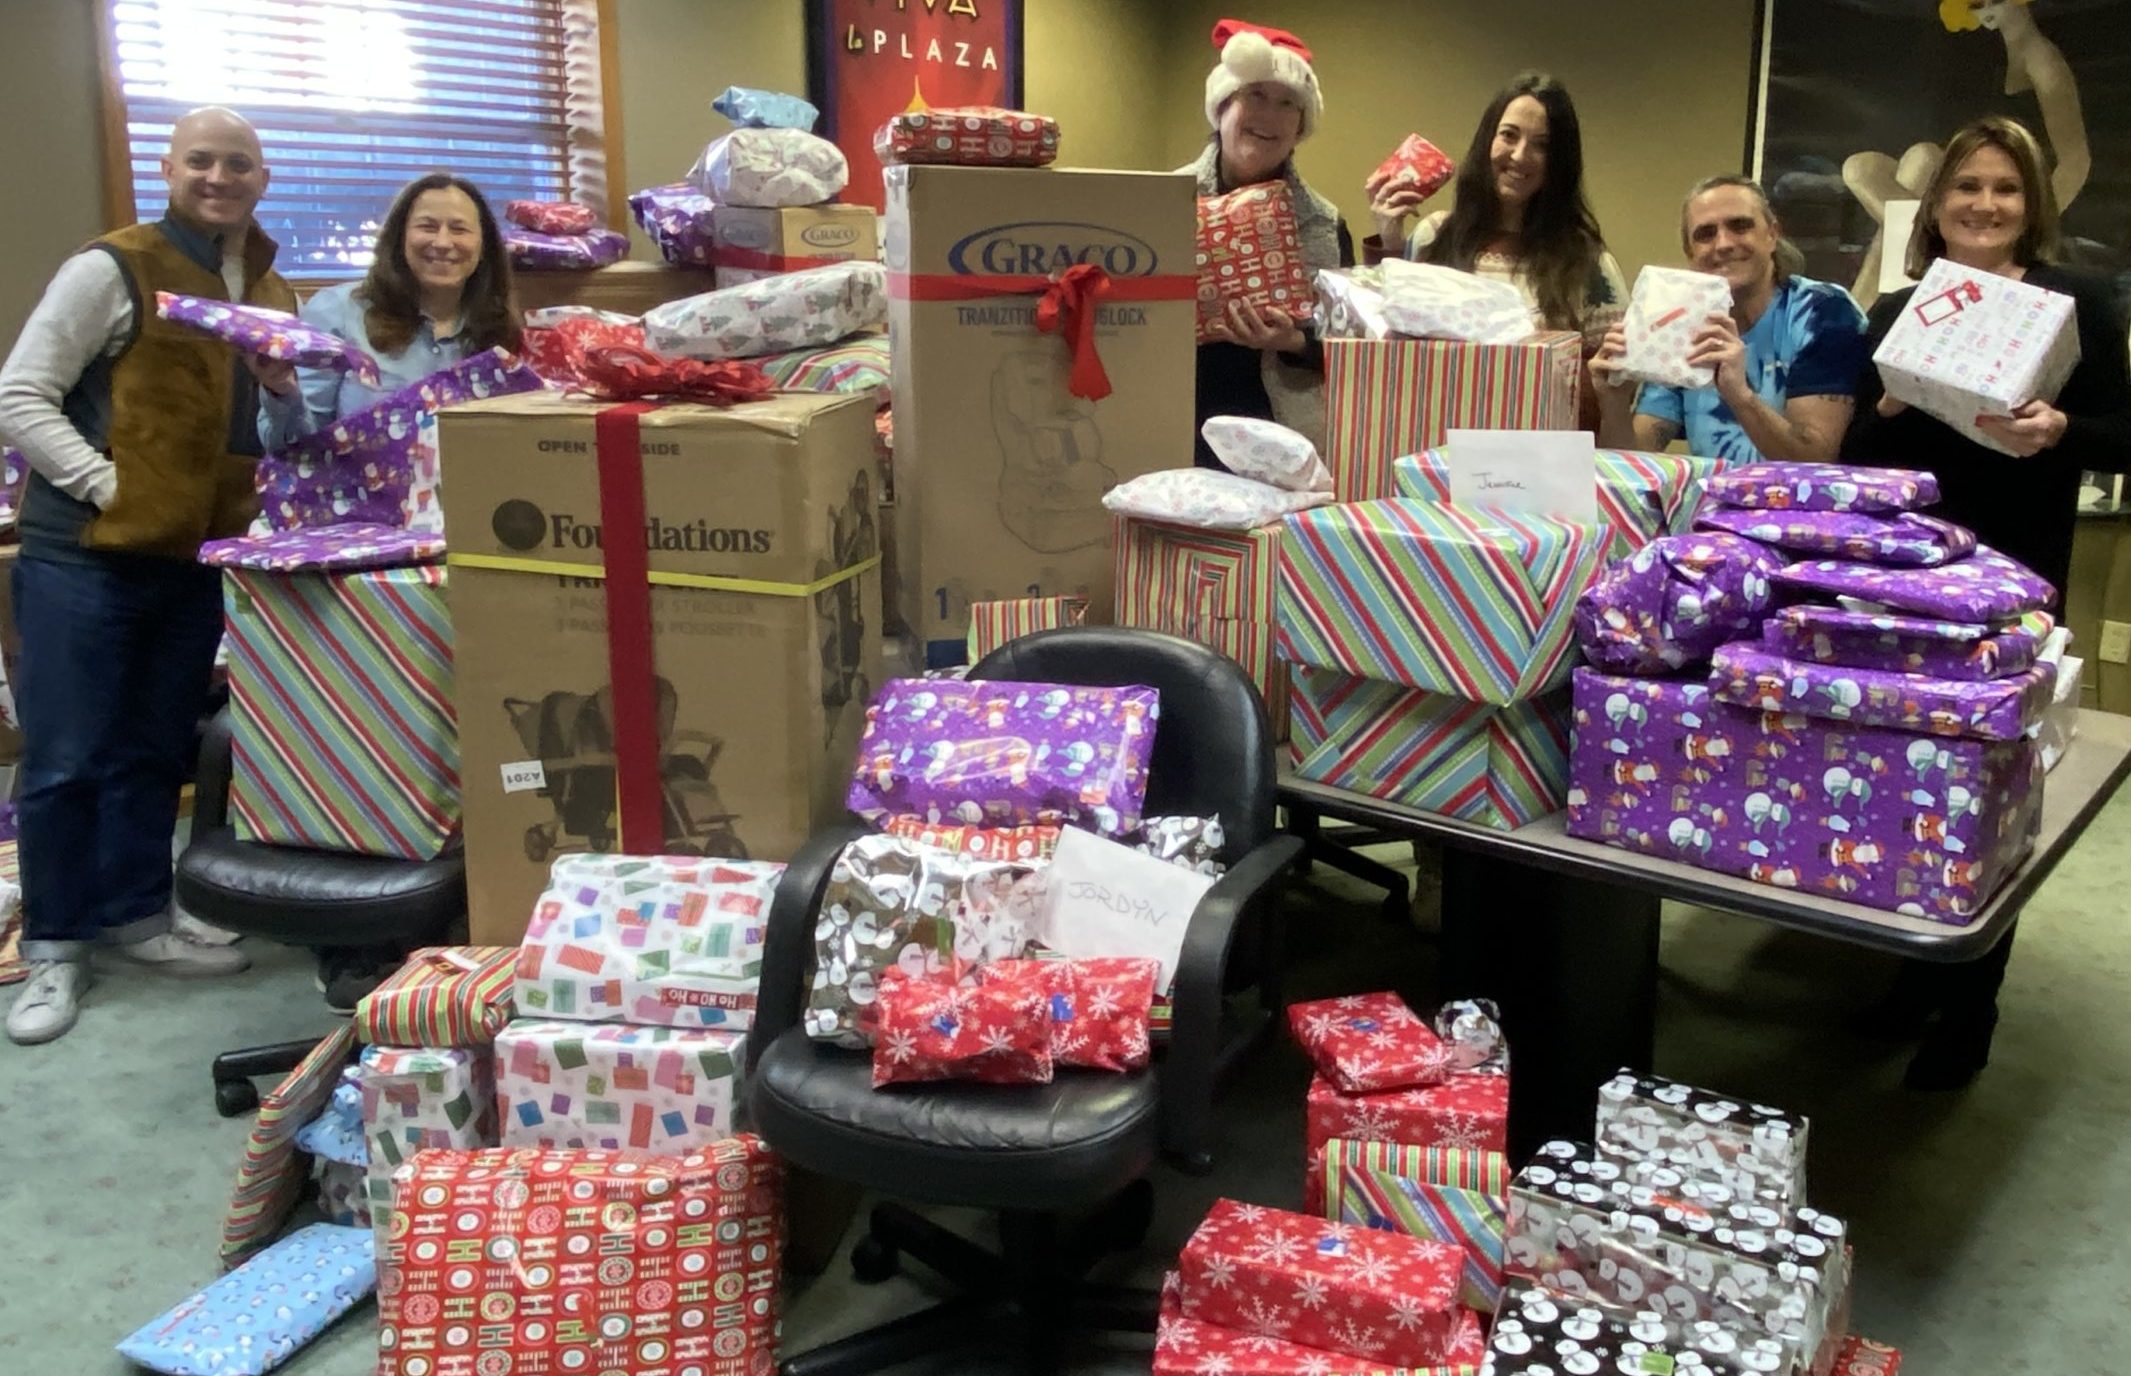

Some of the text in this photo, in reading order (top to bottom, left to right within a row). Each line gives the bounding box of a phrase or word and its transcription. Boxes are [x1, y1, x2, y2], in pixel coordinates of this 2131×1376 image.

[873, 29, 998, 71] PLAZA
[810, 229, 855, 241] GRACO
[982, 237, 1137, 275] GRACO
[537, 440, 587, 453] OPEN
[550, 513, 771, 553] Fodations
[1068, 882, 1168, 927] JORDYN
